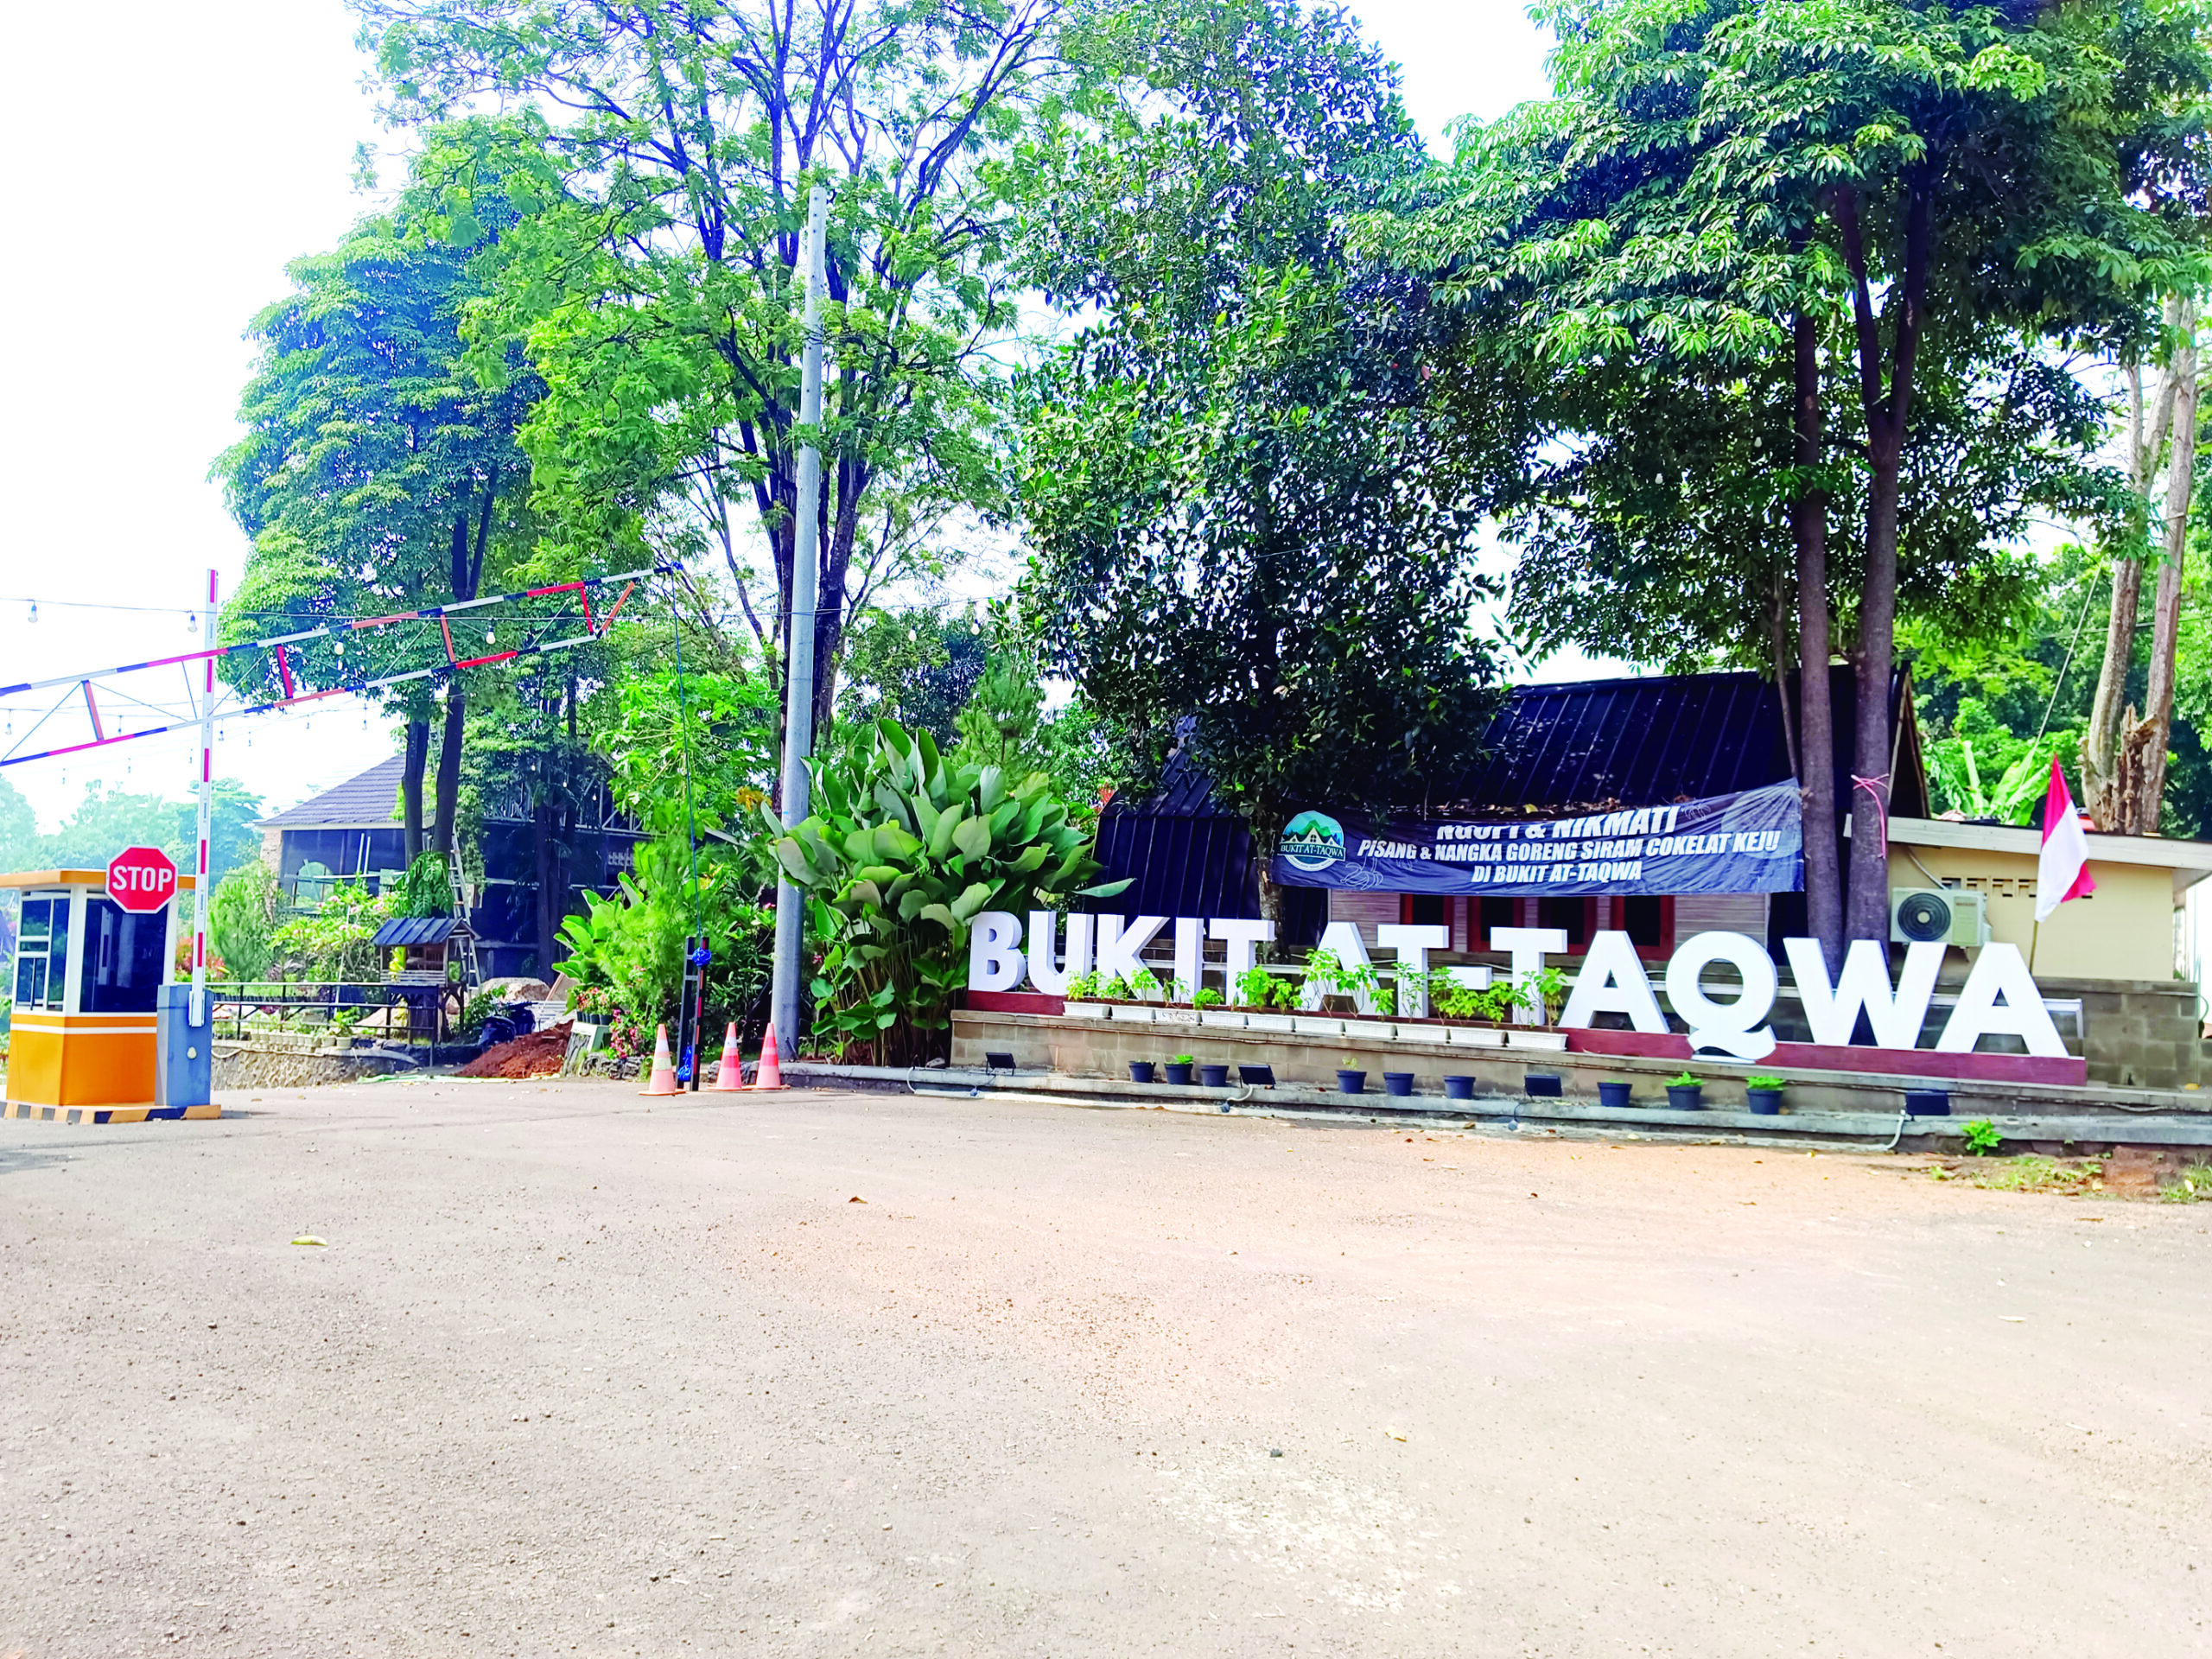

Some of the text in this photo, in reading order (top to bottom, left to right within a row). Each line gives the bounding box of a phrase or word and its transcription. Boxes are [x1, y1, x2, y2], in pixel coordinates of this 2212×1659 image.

[1552, 805, 1681, 839] NIKMATI
[1281, 845, 1344, 858] BUKIT AT-TAQWA
[1357, 830, 1782, 862] PISANG & NANGKA GORENG SIRAM COKELAT KEJU
[111, 865, 173, 893] STOP
[1471, 861, 1642, 883] DI BUKIT AT-TAQWA
[968, 911, 2070, 1063] BUKIT AT-TAQWA
